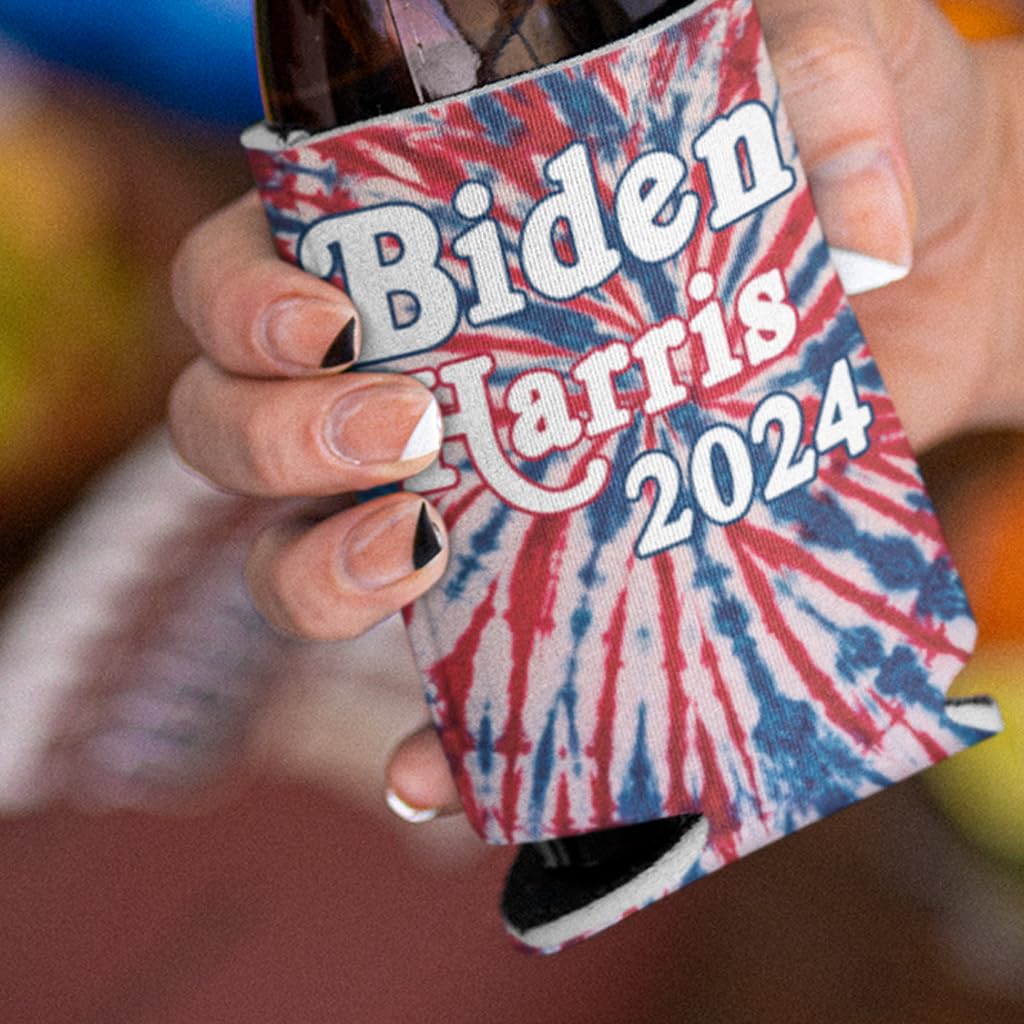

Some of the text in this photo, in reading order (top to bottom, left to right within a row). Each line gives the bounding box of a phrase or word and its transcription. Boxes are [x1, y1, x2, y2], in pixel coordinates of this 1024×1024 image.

[297, 100, 796, 365] Biden
[403, 268, 798, 513] Harris
[625, 357, 872, 559] 2024
